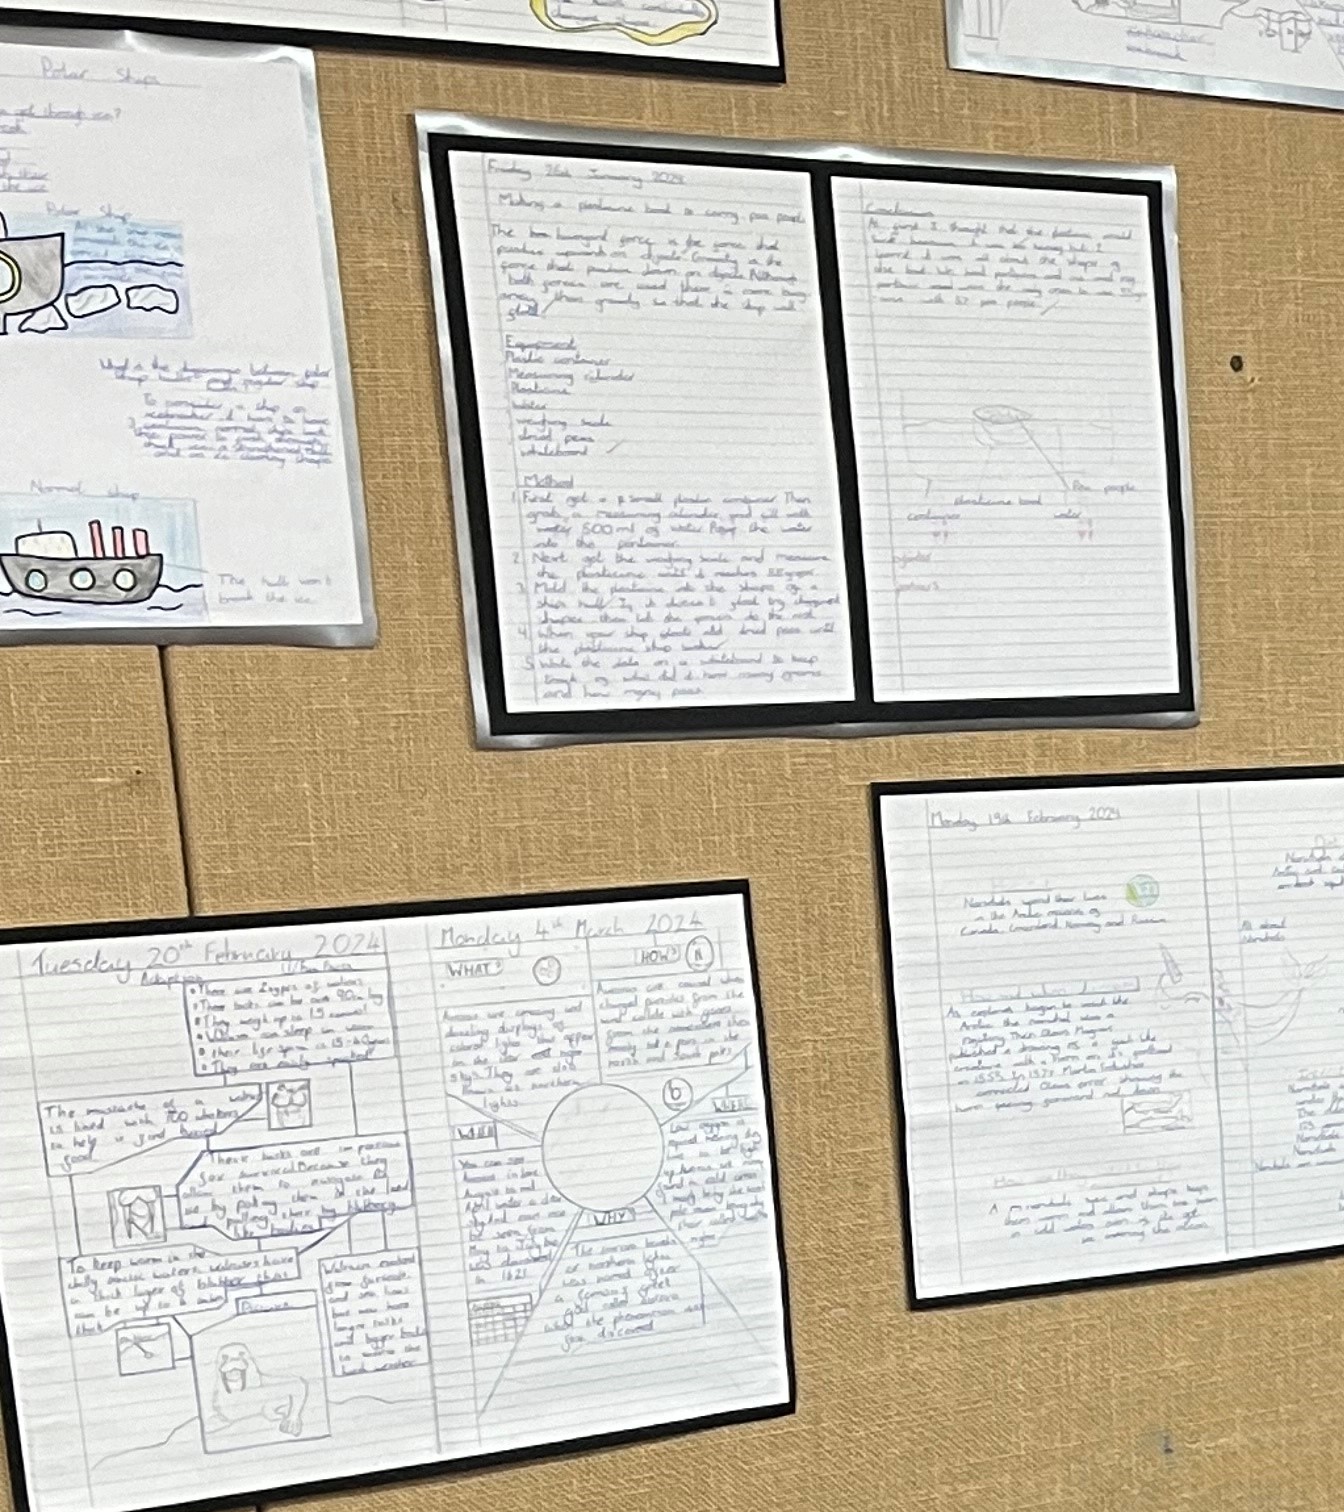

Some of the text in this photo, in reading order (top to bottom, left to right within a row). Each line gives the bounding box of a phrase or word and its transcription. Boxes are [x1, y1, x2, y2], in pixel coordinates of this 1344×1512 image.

[441, 926, 522, 957] Monday
[575, 916, 624, 938] March
[646, 910, 703, 934] 2024
[32, 950, 131, 984] Tuesday
[205, 936, 292, 965] February
[316, 933, 382, 956] 2024
